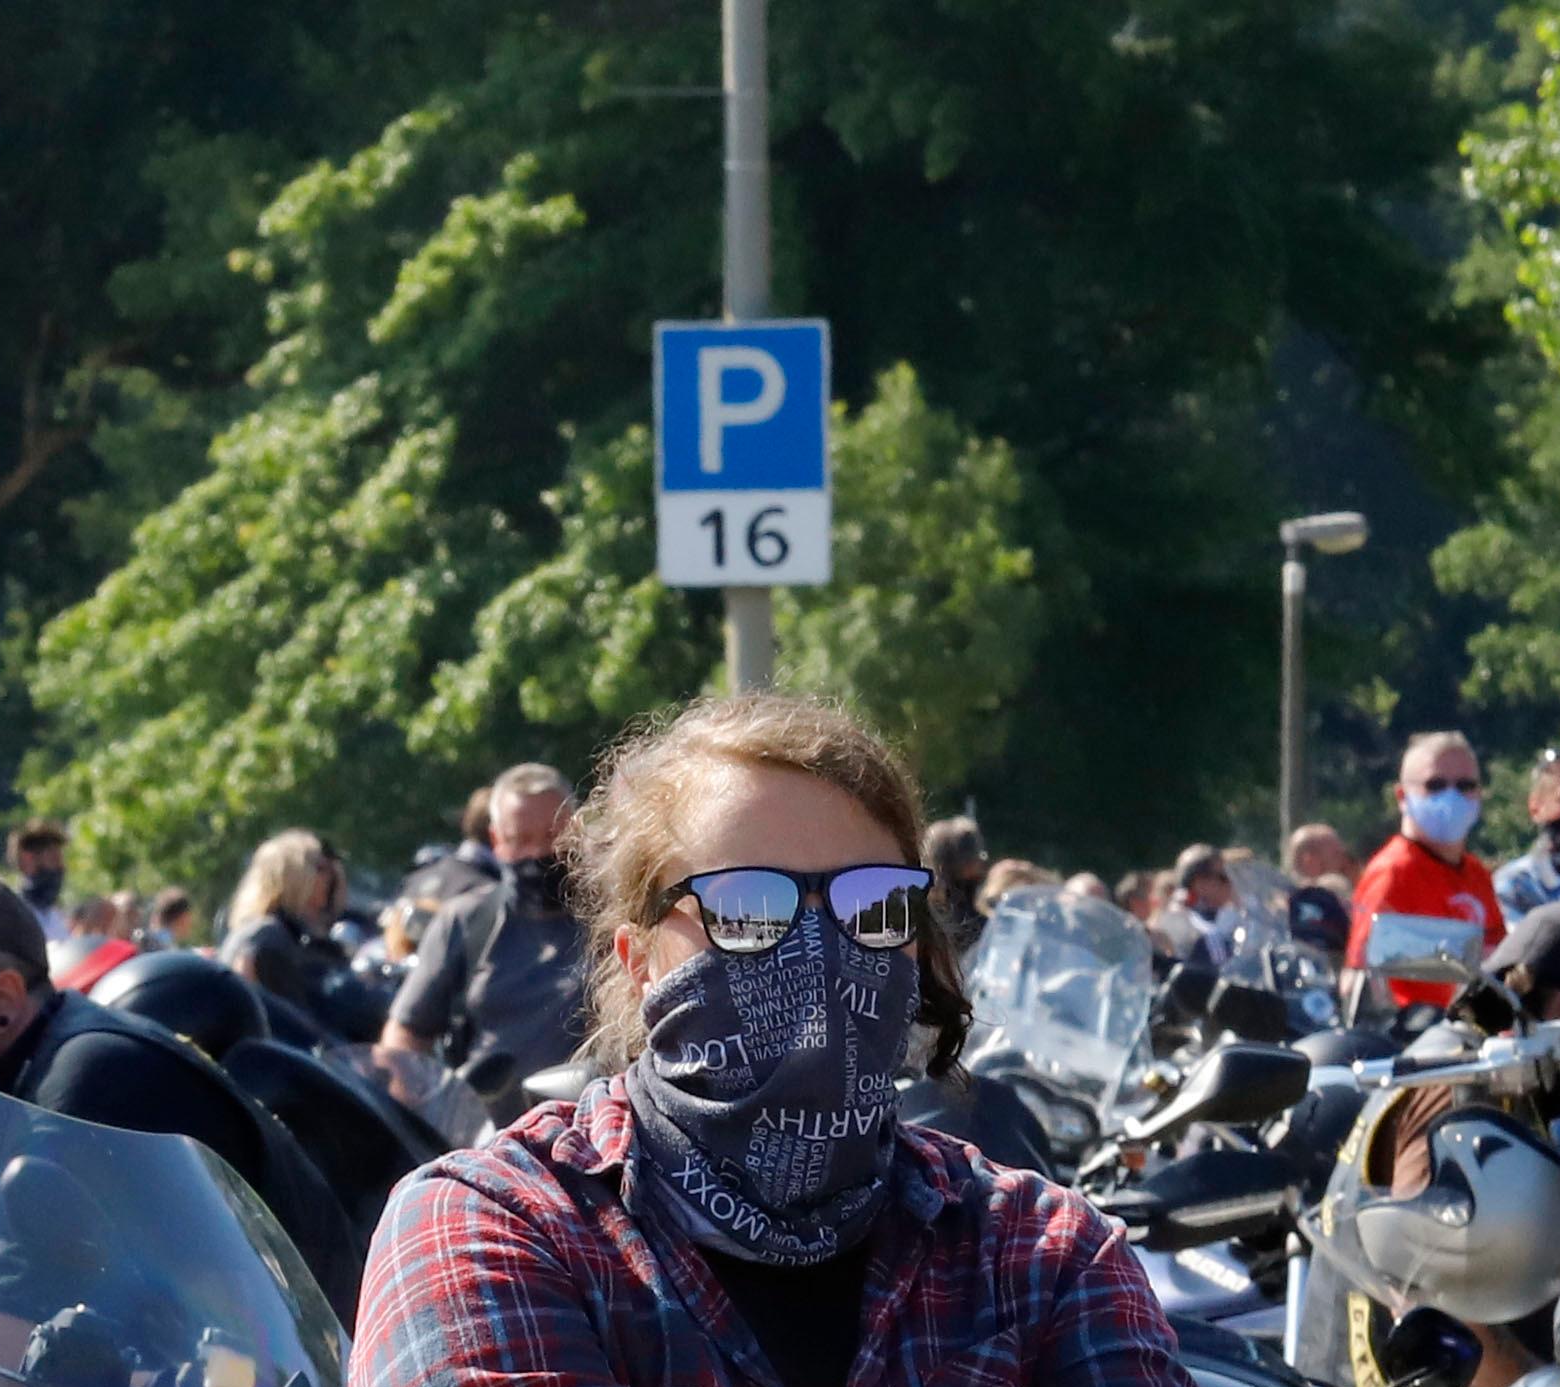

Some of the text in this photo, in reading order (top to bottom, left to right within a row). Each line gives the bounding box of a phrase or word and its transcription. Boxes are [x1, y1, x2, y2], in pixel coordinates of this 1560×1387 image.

[698, 345, 787, 475] P
[700, 505, 789, 567] 16
[803, 907, 826, 958] OMAX
[793, 1034, 827, 1050] DUS
[753, 1107, 886, 1141] ARTHY
[786, 1140, 807, 1197] WILDFIRE
